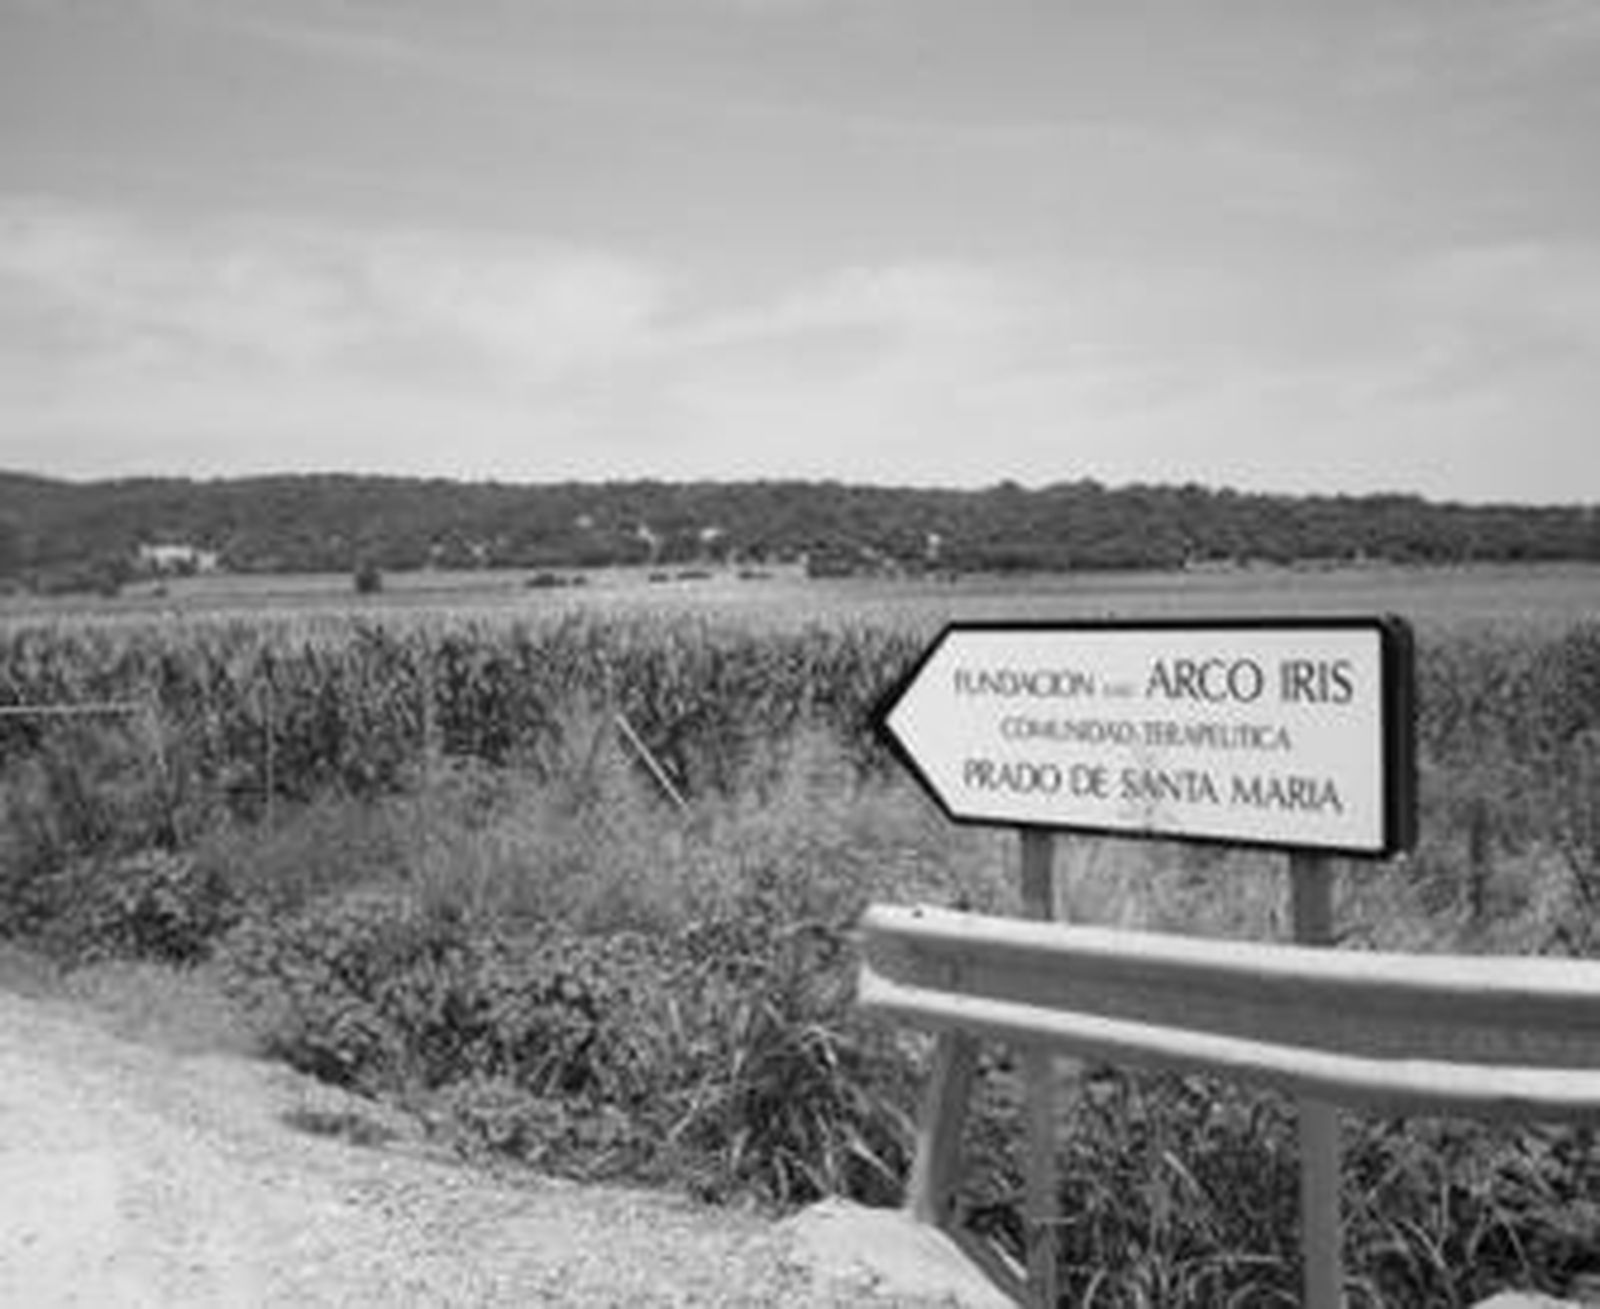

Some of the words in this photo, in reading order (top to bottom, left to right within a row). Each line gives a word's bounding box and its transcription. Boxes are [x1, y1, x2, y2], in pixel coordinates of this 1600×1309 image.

[1145, 656, 1264, 704] ARCO
[1279, 657, 1354, 705] IRIS
[963, 759, 1062, 794] PRADO
[1070, 763, 1110, 799] DE
[1120, 768, 1220, 804] SANTA
[1230, 773, 1344, 817] MARIA
